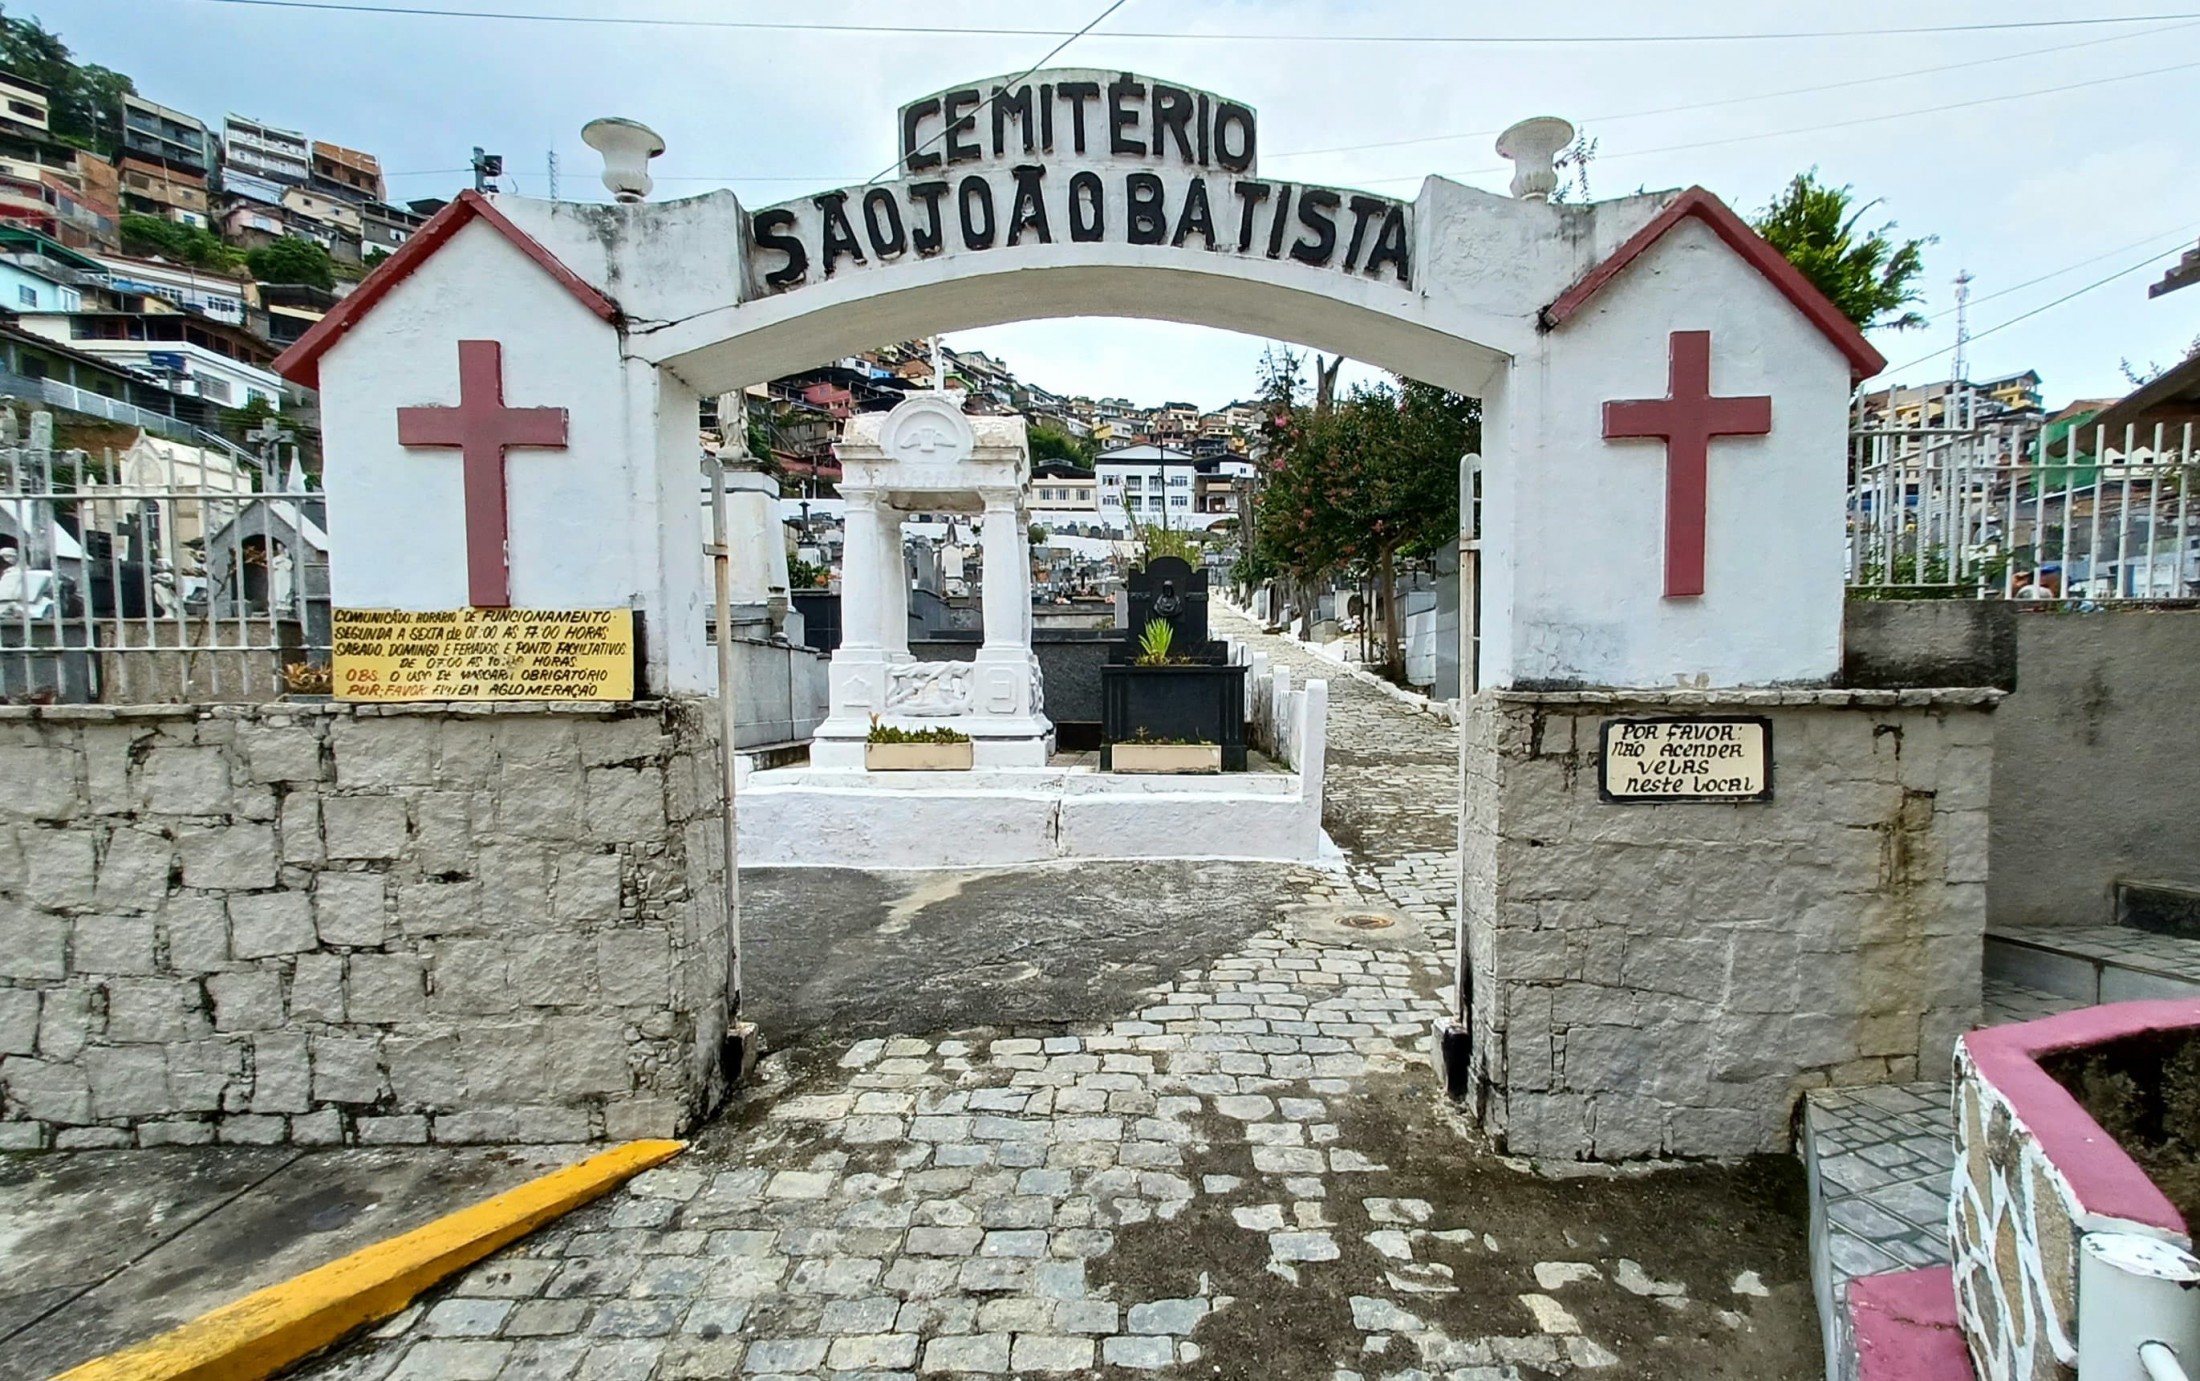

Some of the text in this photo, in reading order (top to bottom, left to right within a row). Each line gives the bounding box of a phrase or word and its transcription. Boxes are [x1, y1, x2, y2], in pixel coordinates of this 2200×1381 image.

[903, 71, 1256, 172] CEMITÉRIO
[754, 164, 1408, 285] SÃO JOÃO BATISTA
[464, 611, 477, 622] DE
[334, 626, 393, 640] SEGUNDA
[397, 627, 406, 640] A
[409, 627, 444, 640] SEXTA
[565, 625, 609, 640] HORAS
[388, 643, 439, 657] DOMINGO
[443, 643, 451, 656] E
[453, 642, 499, 655] FERIADOS
[503, 642, 511, 654] E
[515, 641, 552, 654] PONTO
[399, 658, 416, 668] DE
[533, 656, 577, 667] HORAS
[390, 671, 400, 682] O
[1622, 725, 1659, 740] POR
